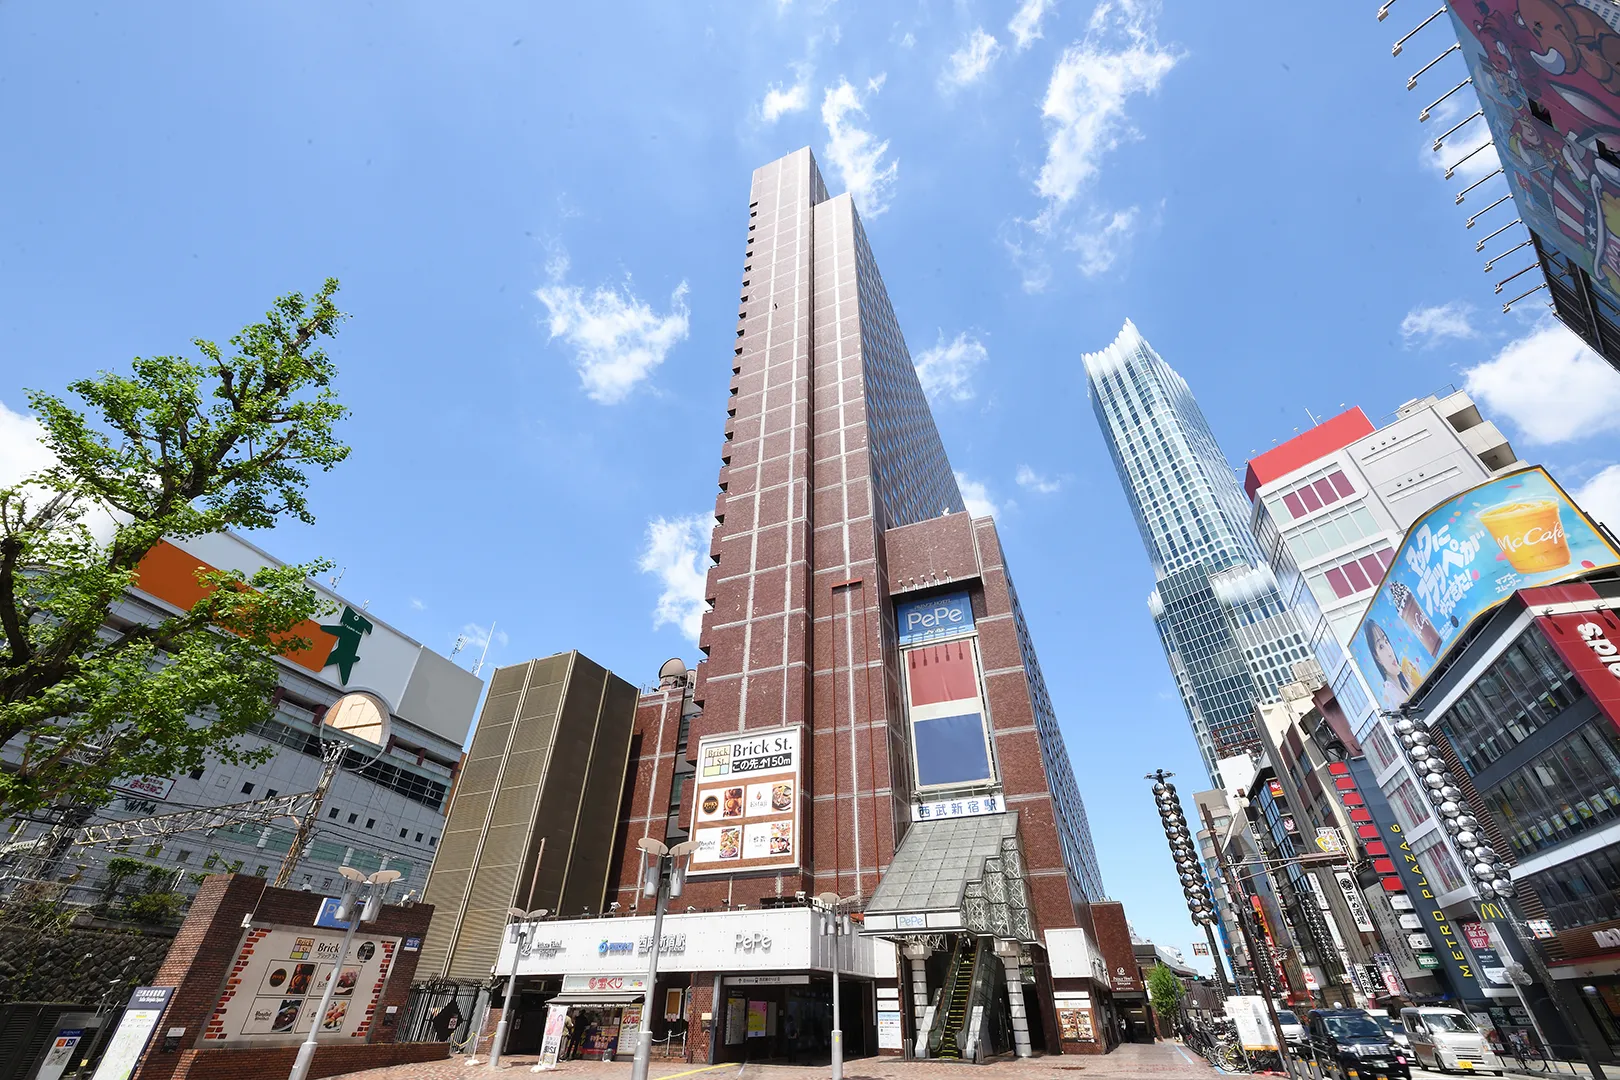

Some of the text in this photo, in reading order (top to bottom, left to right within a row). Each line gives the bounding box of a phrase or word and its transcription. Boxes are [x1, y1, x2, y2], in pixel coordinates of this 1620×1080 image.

[907, 607, 963, 630] PePe
[707, 747, 729, 758] Brick
[733, 738, 792, 758] Brick St.
[732, 755, 791, 771] この先 150m
[919, 798, 997, 819] 西武新宿駅
[899, 916, 923, 927] PePe
[317, 942, 341, 953] Brick
[734, 931, 772, 950] PePe
[1432, 910, 1473, 978] METRO
[597, 977, 623, 989] 宝くじ
